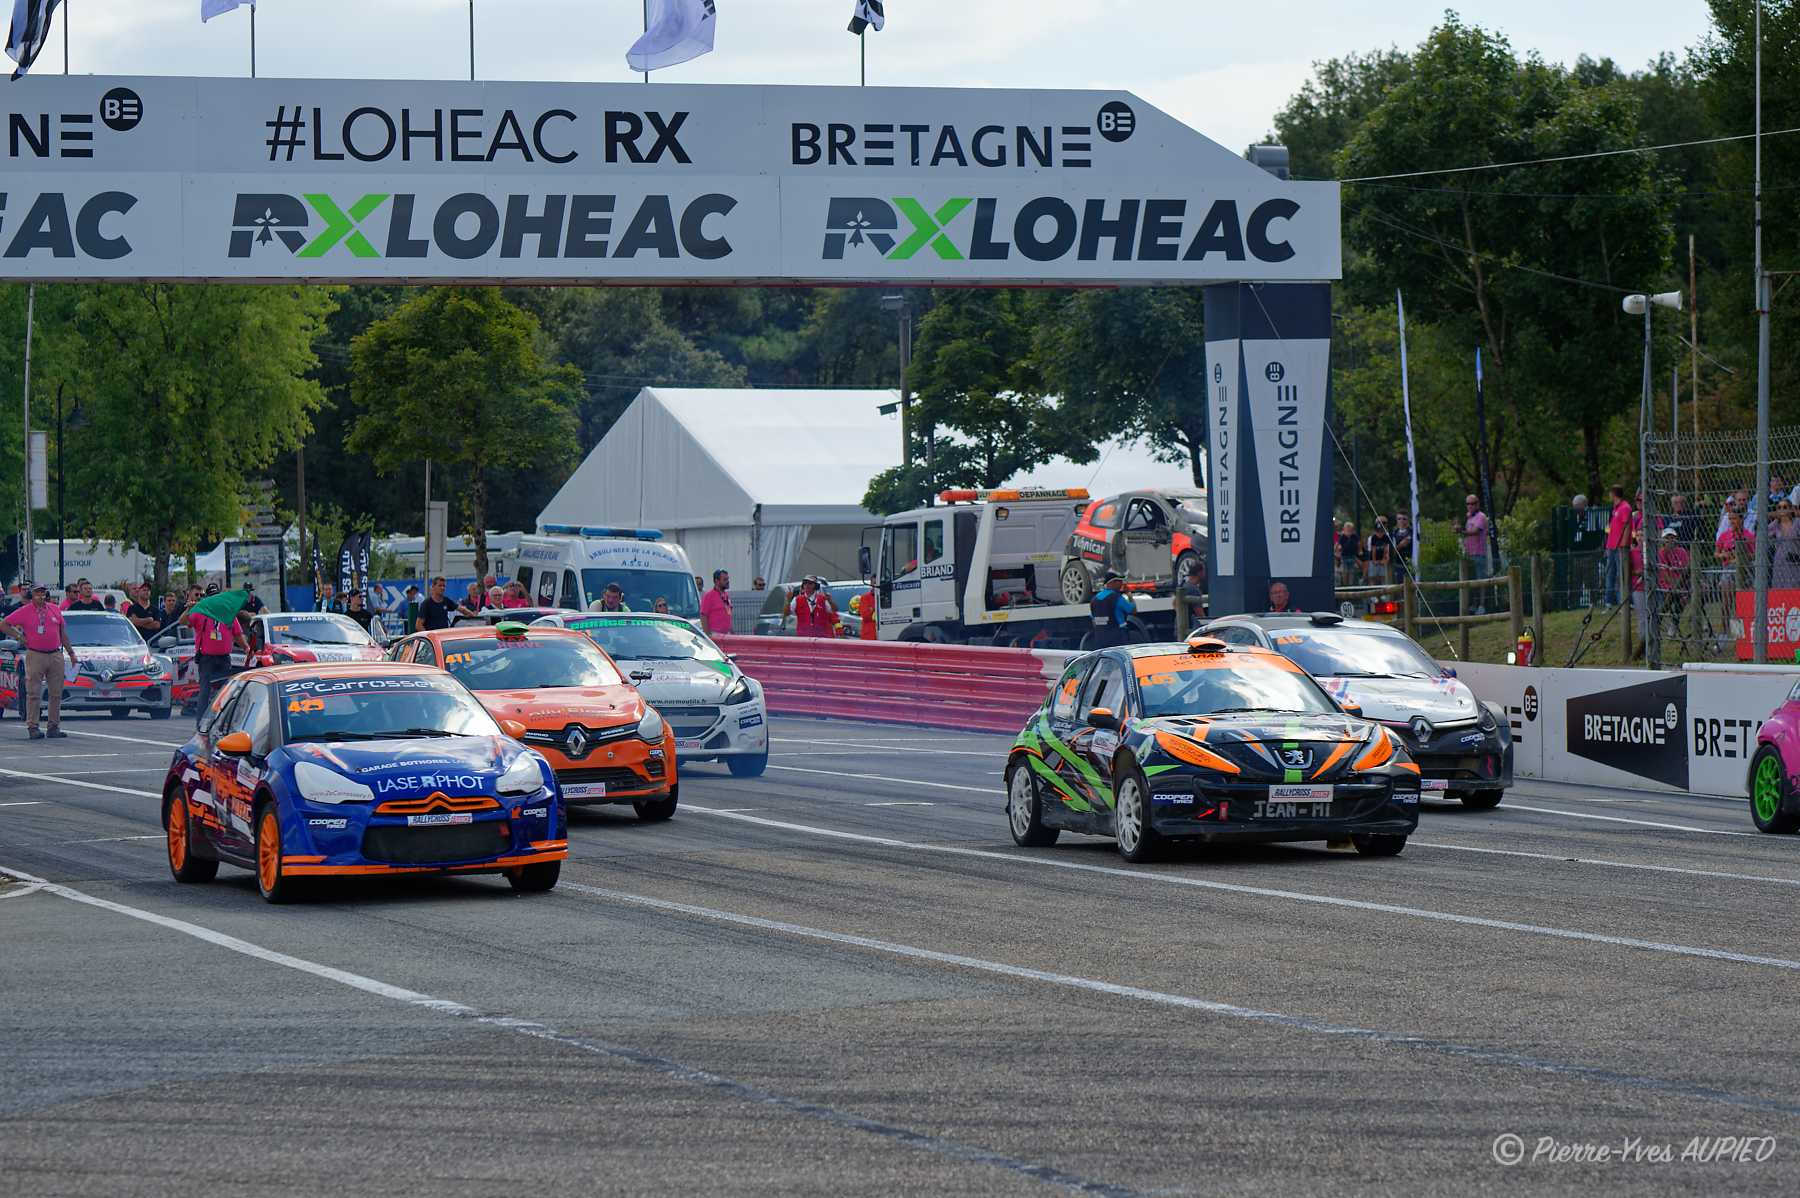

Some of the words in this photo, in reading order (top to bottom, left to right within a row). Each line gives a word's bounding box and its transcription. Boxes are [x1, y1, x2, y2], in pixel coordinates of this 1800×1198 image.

[265, 105, 579, 164] #LOHEAC
[604, 110, 693, 164] RX
[790, 122, 1092, 168] BRETAGNE
[0, 190, 139, 260] AC
[1218, 385, 1230, 544] BRETAGNE
[1277, 384, 1300, 544] BRETAGNE
[920, 565, 954, 578] BRIAND
[1584, 713, 1665, 745] BRETAGNE
[1694, 717, 1762, 758] BRET
[361, 762, 398, 773] GARAGE
[1153, 793, 1195, 801] COOPER
[1273, 788, 1312, 797] RALLYCROSS
[412, 815, 450, 825] RALLYCROSS
[523, 807, 547, 816] COOPER
